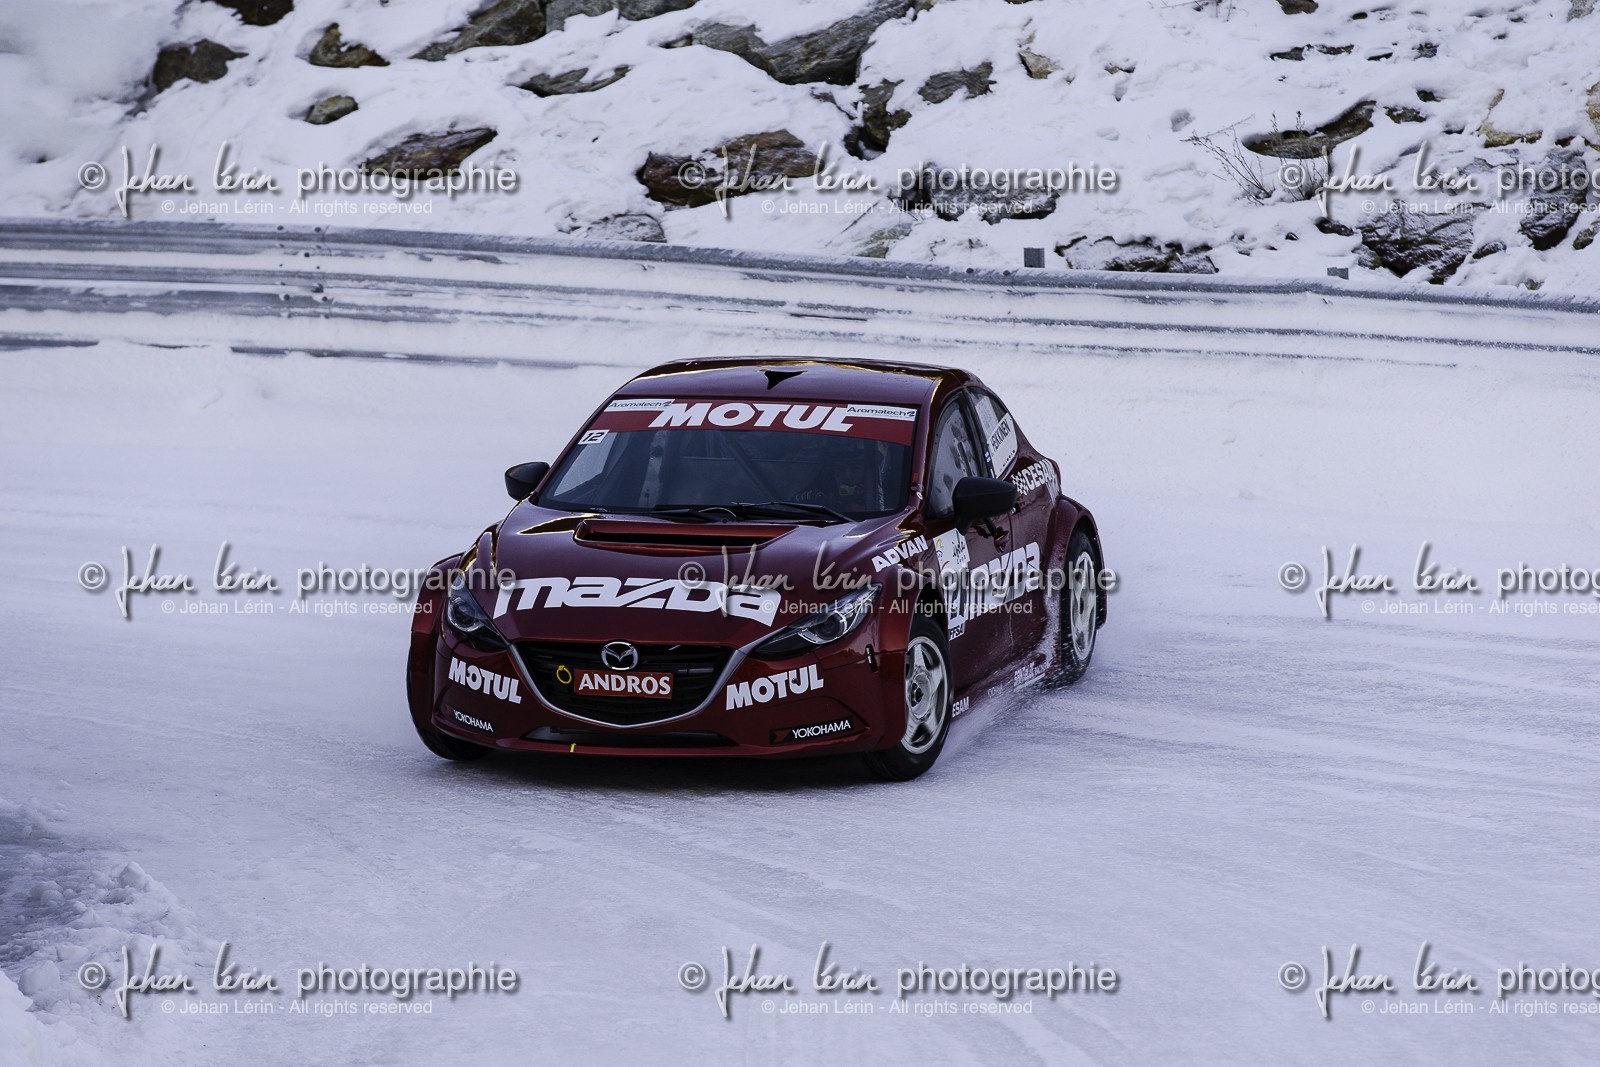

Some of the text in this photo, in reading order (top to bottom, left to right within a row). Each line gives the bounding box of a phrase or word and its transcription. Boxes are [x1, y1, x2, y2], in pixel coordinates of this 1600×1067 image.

[649, 401, 855, 432] MOTUL
[846, 406, 907, 416] Aromatech
[581, 431, 605, 443] 12
[871, 535, 929, 573] ADVAN
[448, 656, 522, 704] MOTUL
[578, 673, 672, 696] ANDROS
[725, 664, 824, 711] MOTUL
[453, 709, 494, 733] YOKOHAMA
[791, 718, 852, 740] YOKOHAMA
